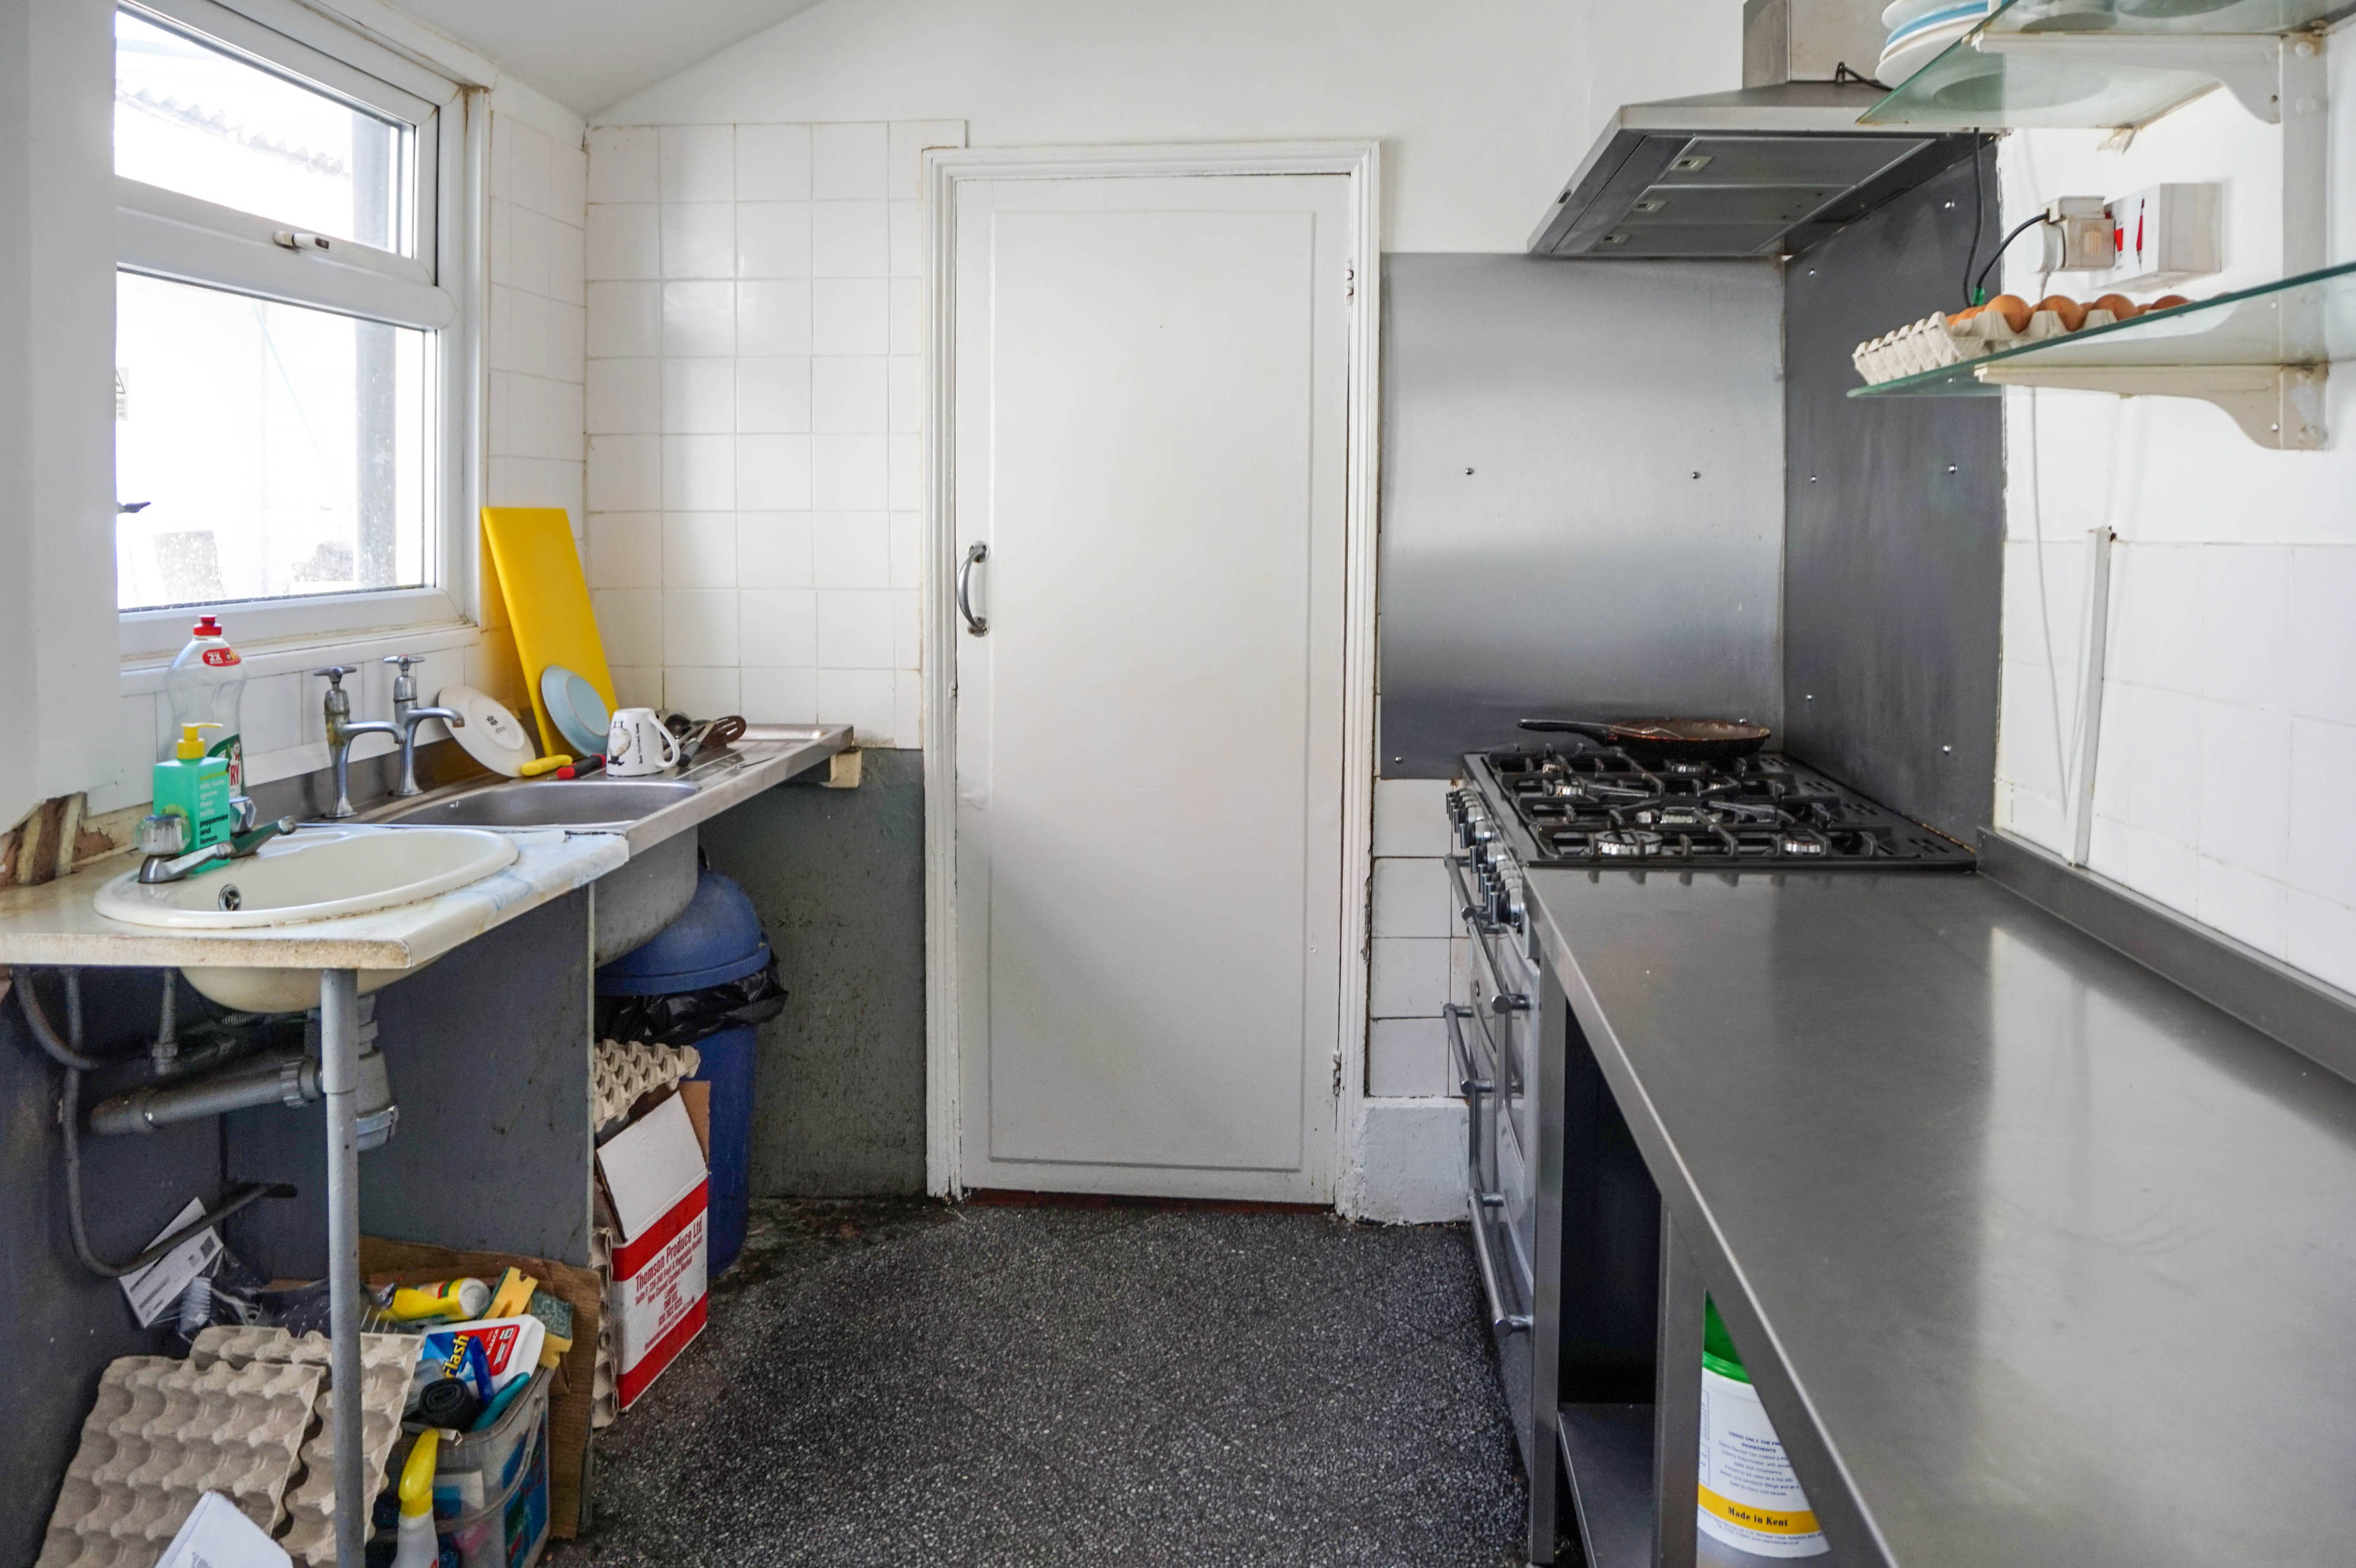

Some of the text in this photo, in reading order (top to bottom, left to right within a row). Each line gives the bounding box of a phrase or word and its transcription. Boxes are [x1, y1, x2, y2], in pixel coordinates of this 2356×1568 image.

[229, 763, 239, 786] RY
[200, 813, 228, 828] peppermint
[200, 826, 211, 836] and
[200, 836, 217, 845] lemon
[636, 1216, 702, 1292] Thomson Produce Ltd
[1728, 1506, 1750, 1520] Made
[1754, 1515, 1763, 1524] in
[1766, 1516, 1788, 1527] Kent
